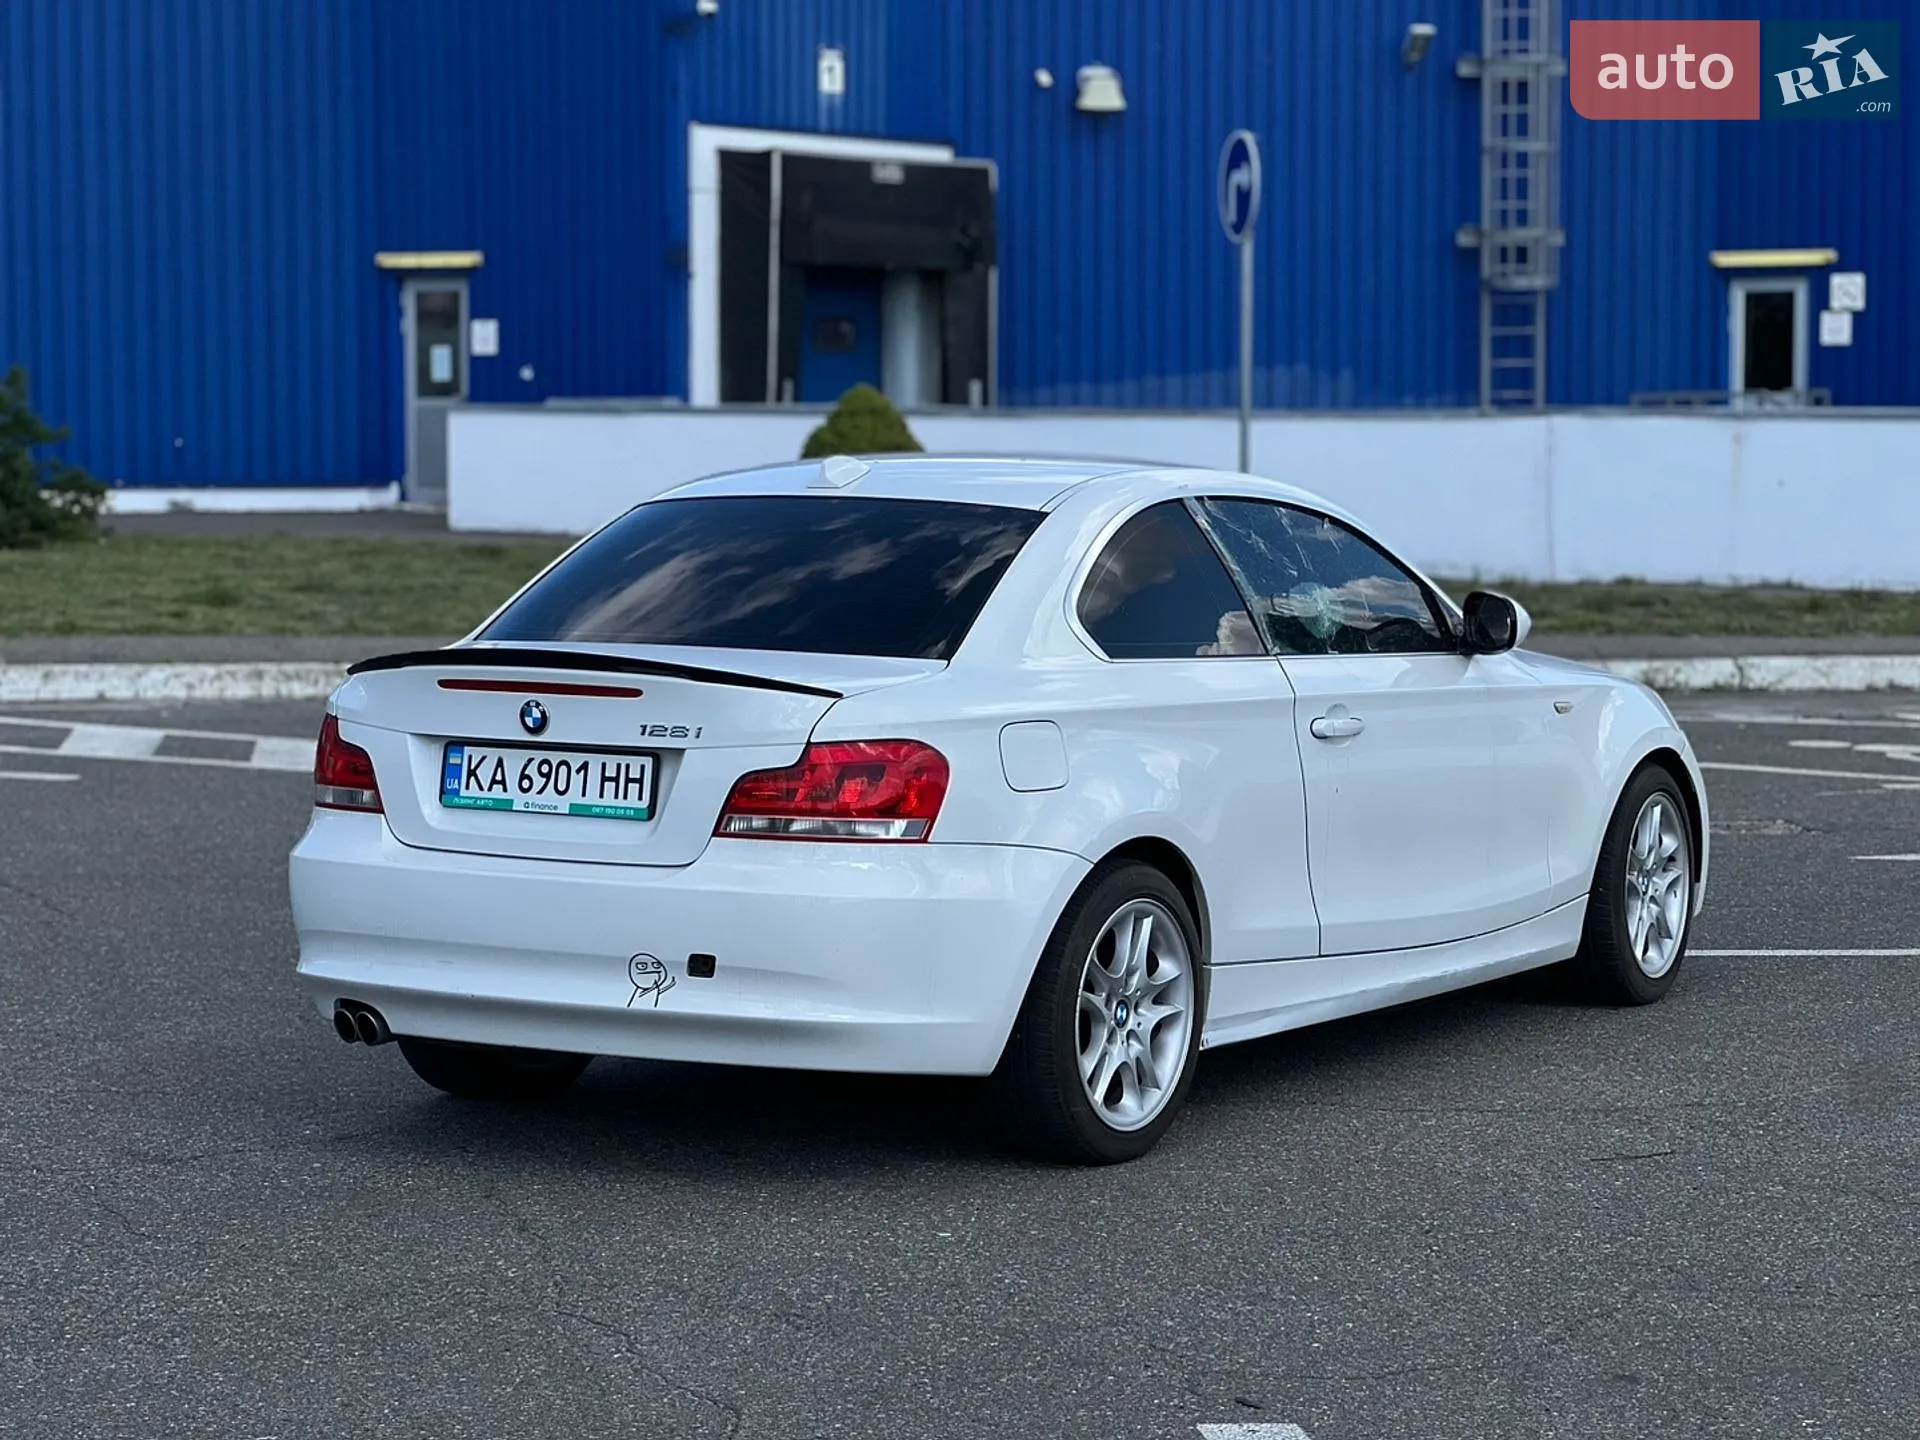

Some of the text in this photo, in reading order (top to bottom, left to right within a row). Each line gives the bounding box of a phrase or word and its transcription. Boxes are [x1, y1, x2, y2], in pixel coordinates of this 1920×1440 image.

[446, 778, 459, 790] UA
[465, 754, 646, 801] KA 6901 HH
